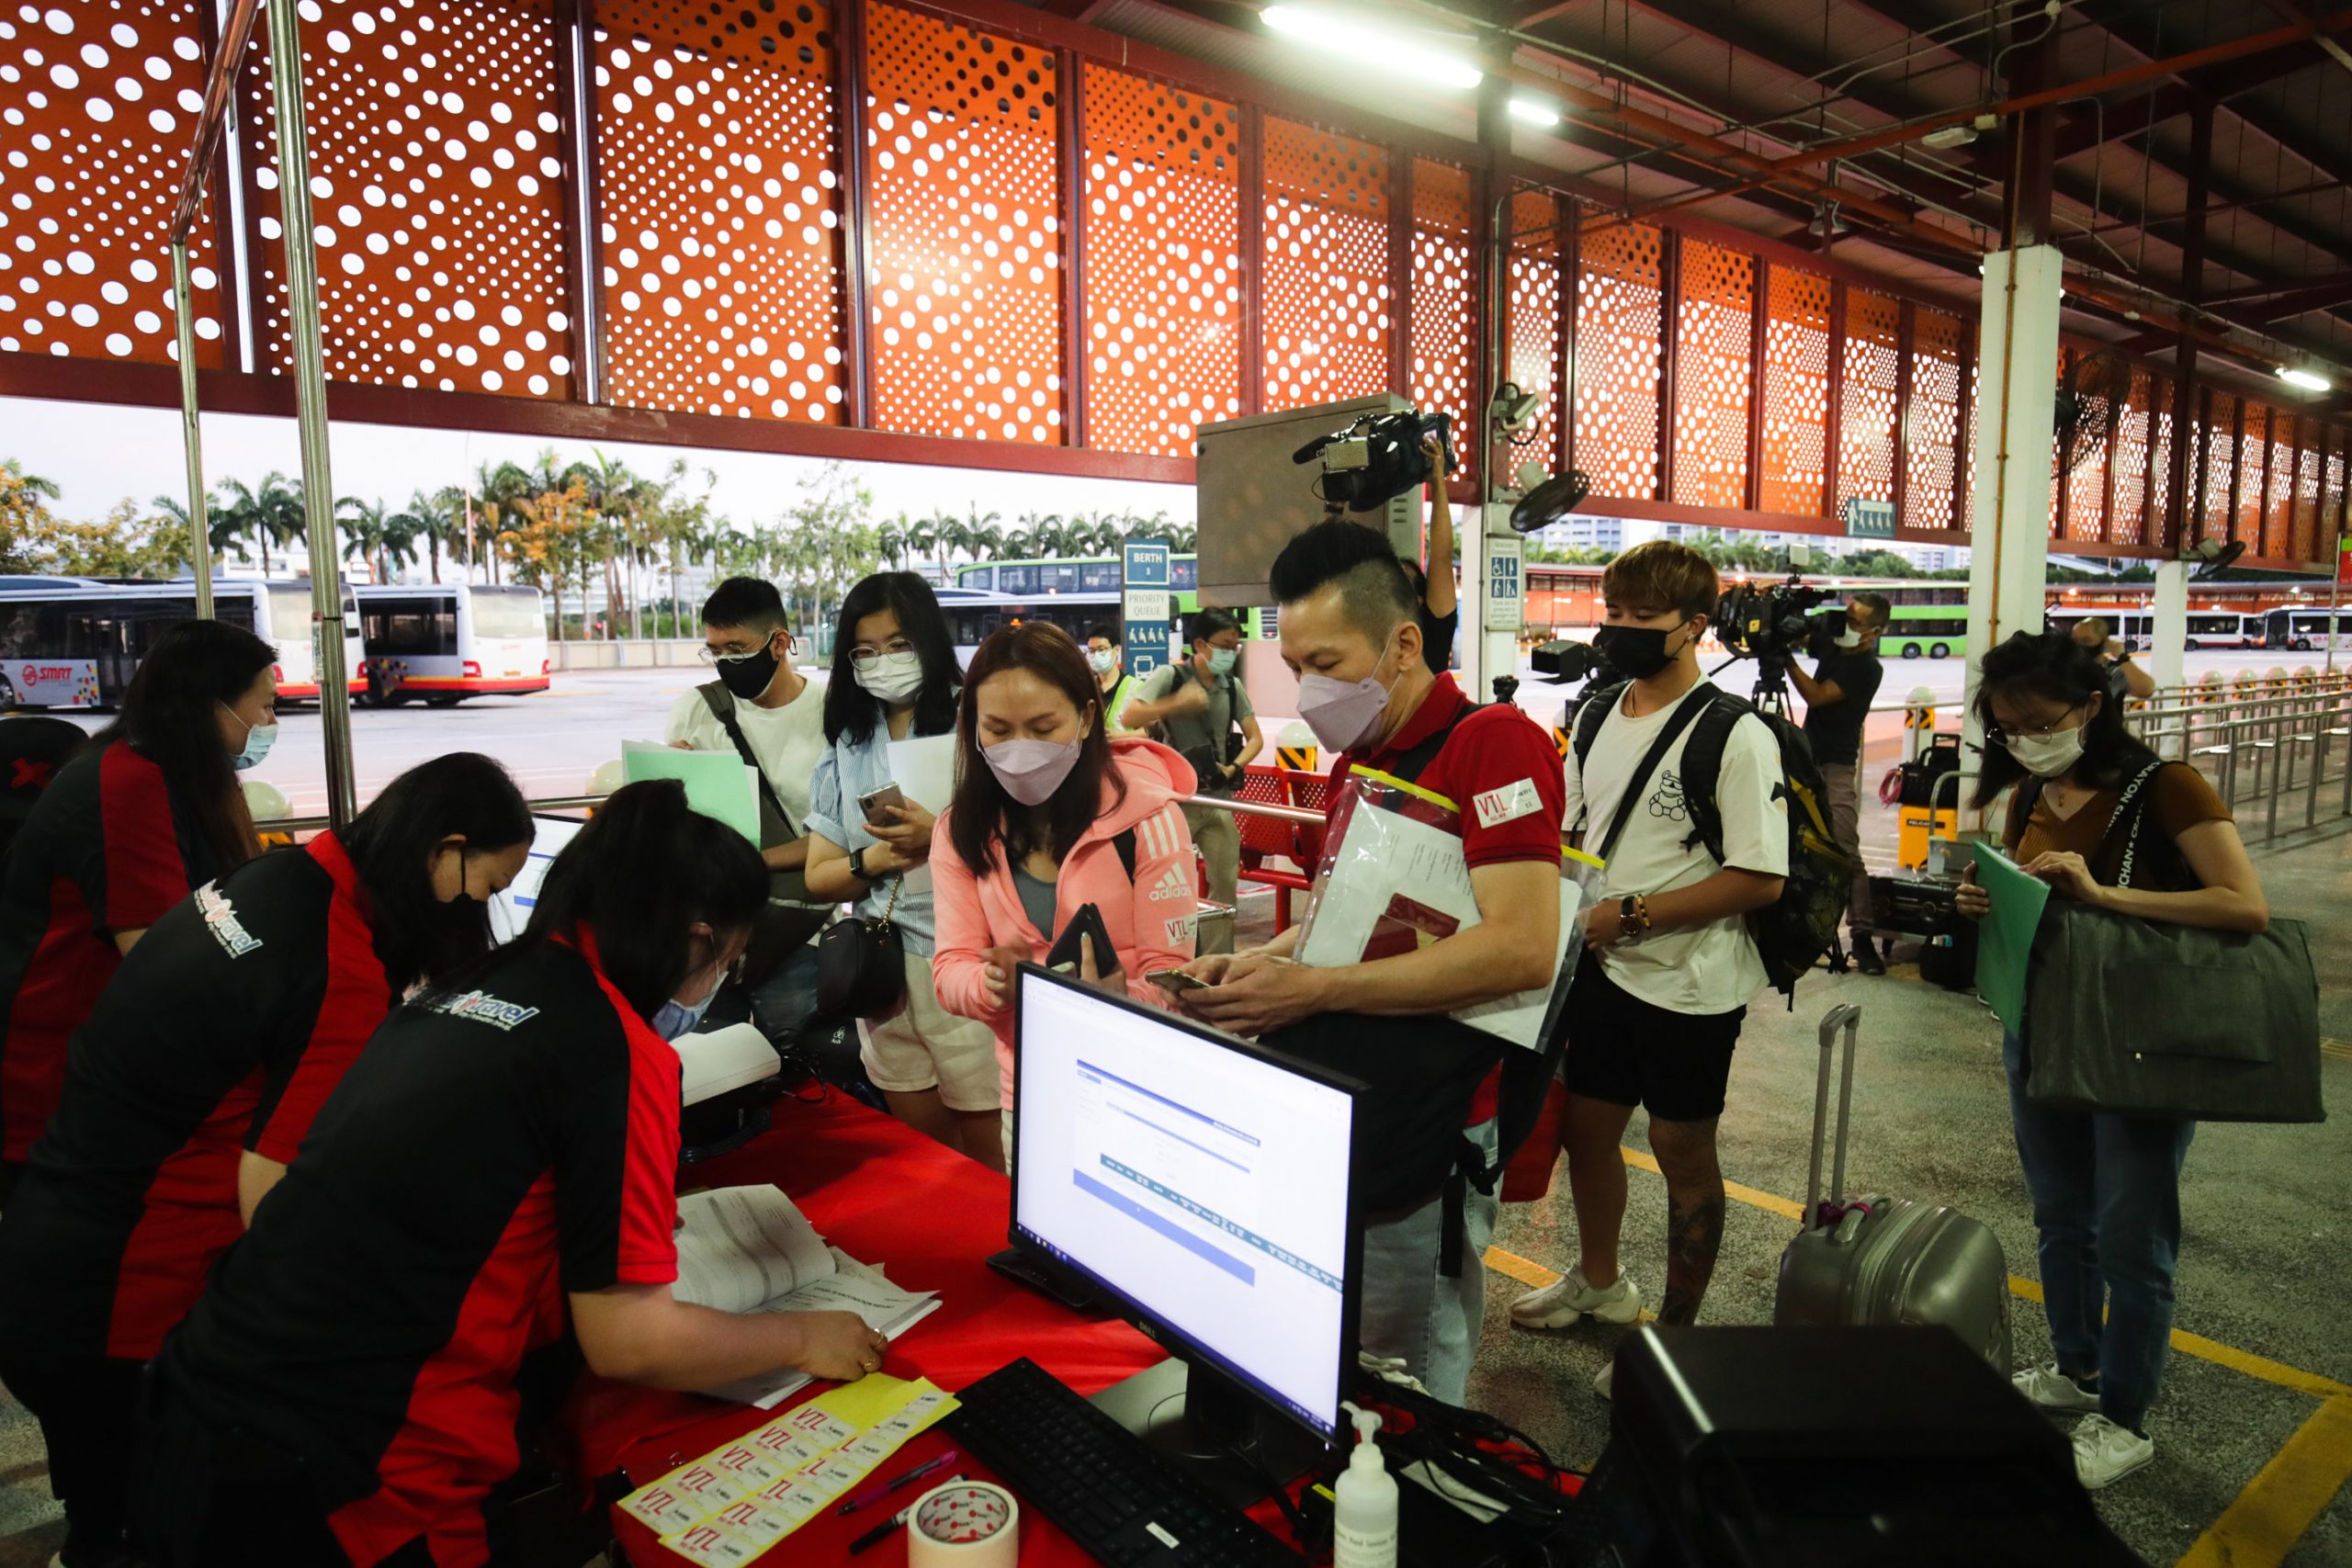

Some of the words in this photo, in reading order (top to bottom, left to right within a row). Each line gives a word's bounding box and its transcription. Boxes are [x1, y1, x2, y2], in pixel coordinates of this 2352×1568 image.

[1133, 552, 1163, 563] BERTH
[1128, 593, 1165, 604] PRIORITY
[1133, 605, 1161, 616] QUEUE
[40, 668, 72, 680] SMRT
[1477, 794, 1510, 817] VTL
[1148, 885, 1193, 902] adidas
[1166, 919, 1189, 938] VTL
[795, 1406, 830, 1432] VTL
[759, 1426, 793, 1451] VTL
[721, 1445, 756, 1471] VTL
[682, 1465, 717, 1493] VTL
[640, 1486, 677, 1516] VTL
[683, 1524, 721, 1552] VTL
